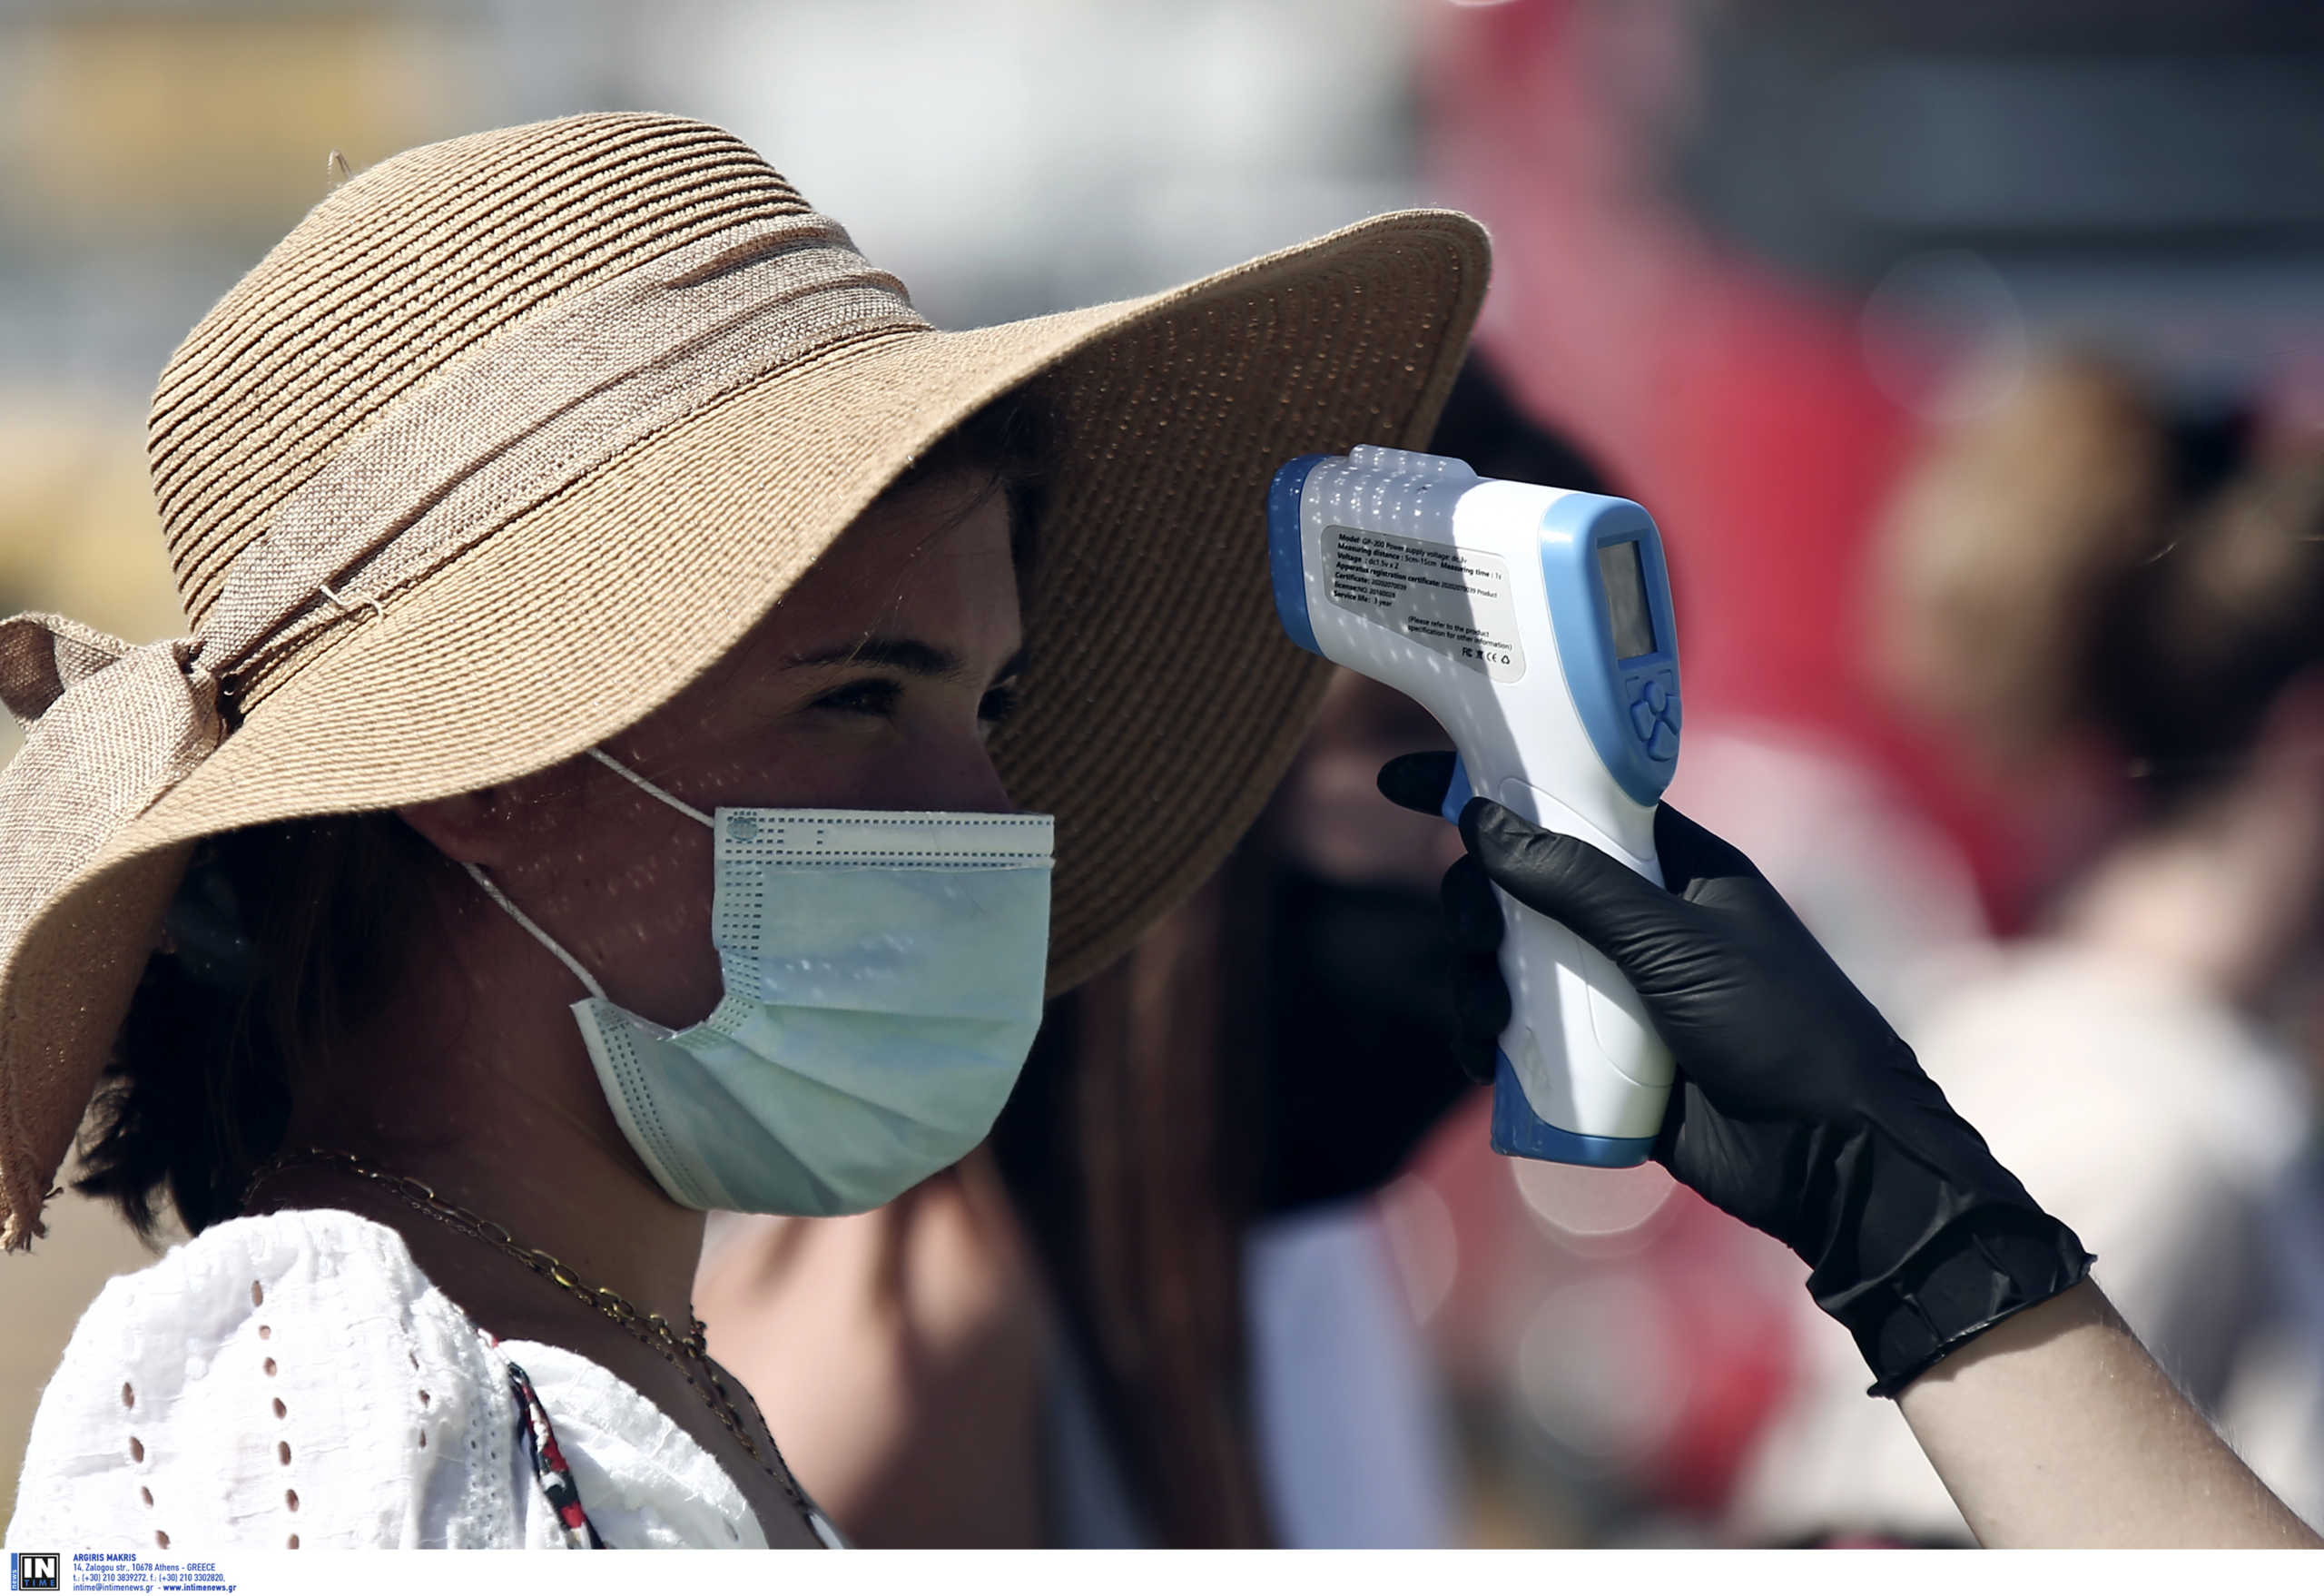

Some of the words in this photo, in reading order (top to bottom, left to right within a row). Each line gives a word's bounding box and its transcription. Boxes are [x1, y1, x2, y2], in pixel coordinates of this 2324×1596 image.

[1337, 551, 1362, 563] Voltage
[1337, 542, 1372, 557] Measuring
[1373, 549, 1400, 559] distance
[1440, 561, 1474, 576] Measuring
[1475, 568, 1490, 577] time
[1405, 547, 1425, 557] supply
[1370, 568, 1407, 580] registration
[1477, 588, 1498, 598] Product
[1334, 590, 1357, 600] Service
[1408, 616, 1431, 626] (Please
[1431, 620, 1445, 628] refer
[1446, 623, 1453, 631] to
[1454, 625, 1465, 633] the
[1465, 627, 1490, 638] product
[1408, 625, 1446, 638] specification
[1447, 631, 1455, 639] for
[1456, 633, 1473, 643] other
[1474, 637, 1513, 651] information)
[1486, 652, 1498, 663] CE
